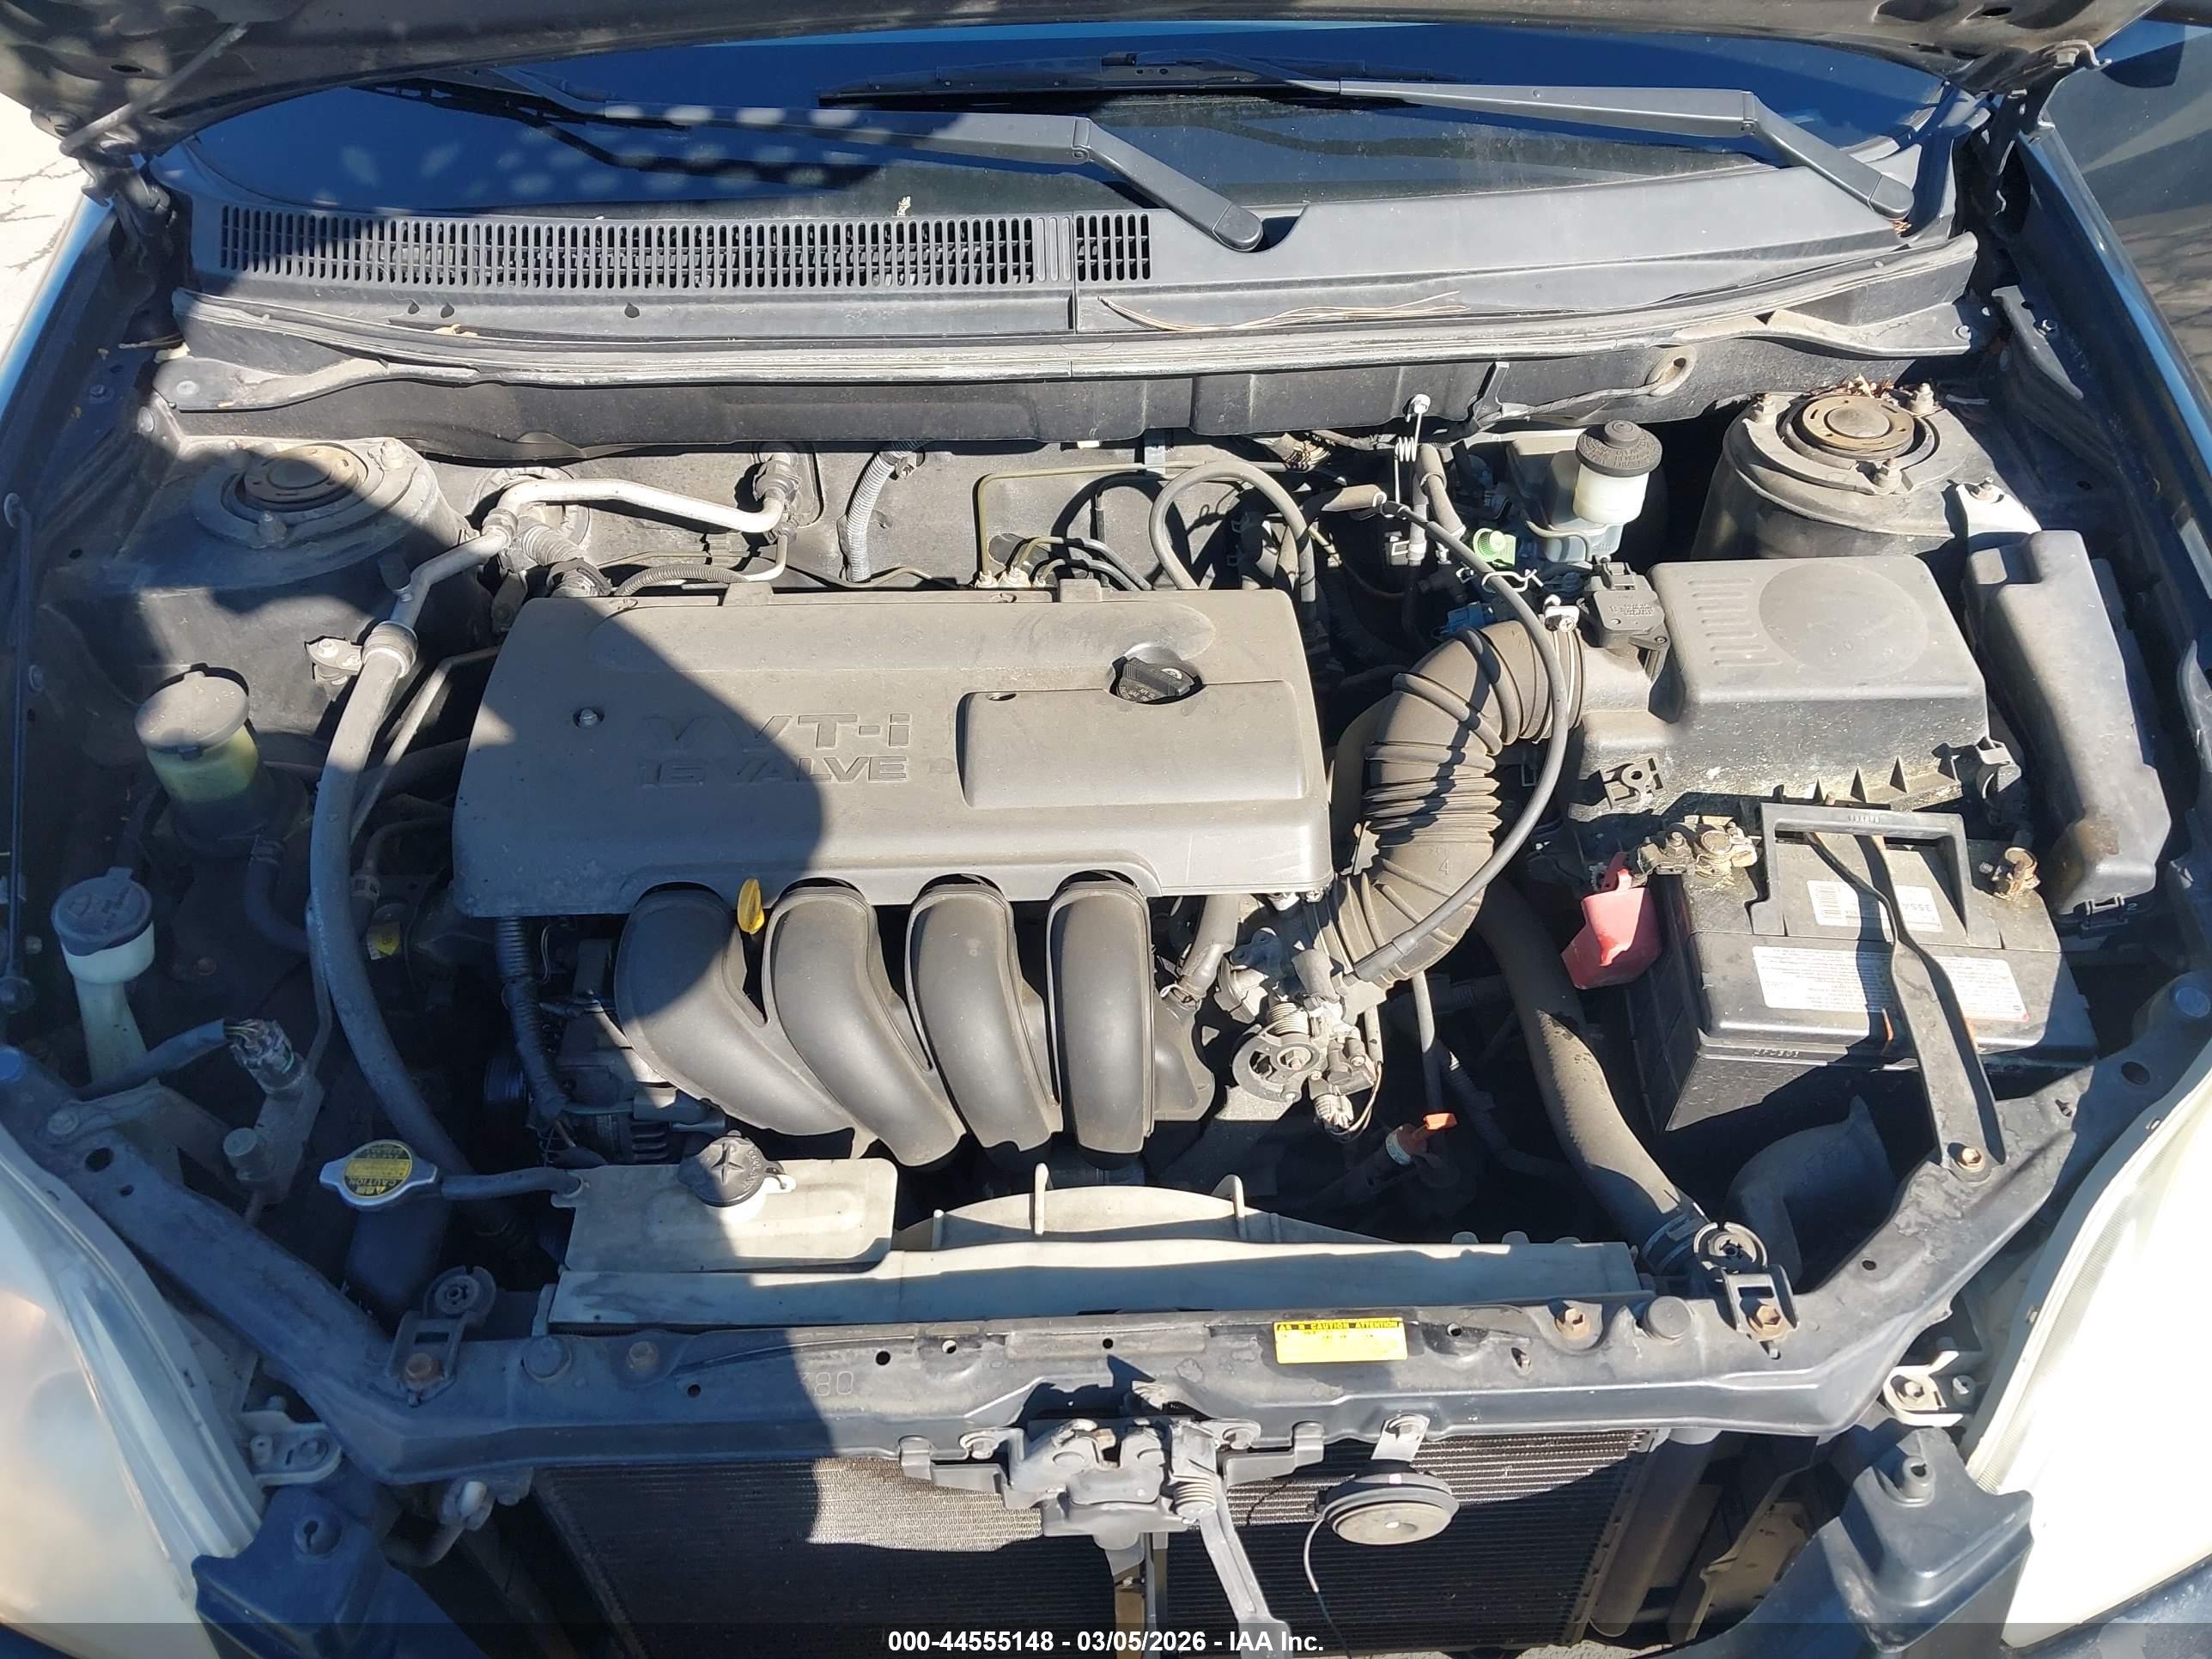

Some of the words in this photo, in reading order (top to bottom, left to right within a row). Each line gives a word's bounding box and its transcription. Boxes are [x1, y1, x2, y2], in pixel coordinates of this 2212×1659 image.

[641, 713, 911, 750] VVT-i
[714, 756, 908, 786] VALVE
[349, 1177, 397, 1188] CAUTION
[1310, 1322, 1350, 1331] CAUTION
[1355, 1321, 1399, 1330] ATTENTION
